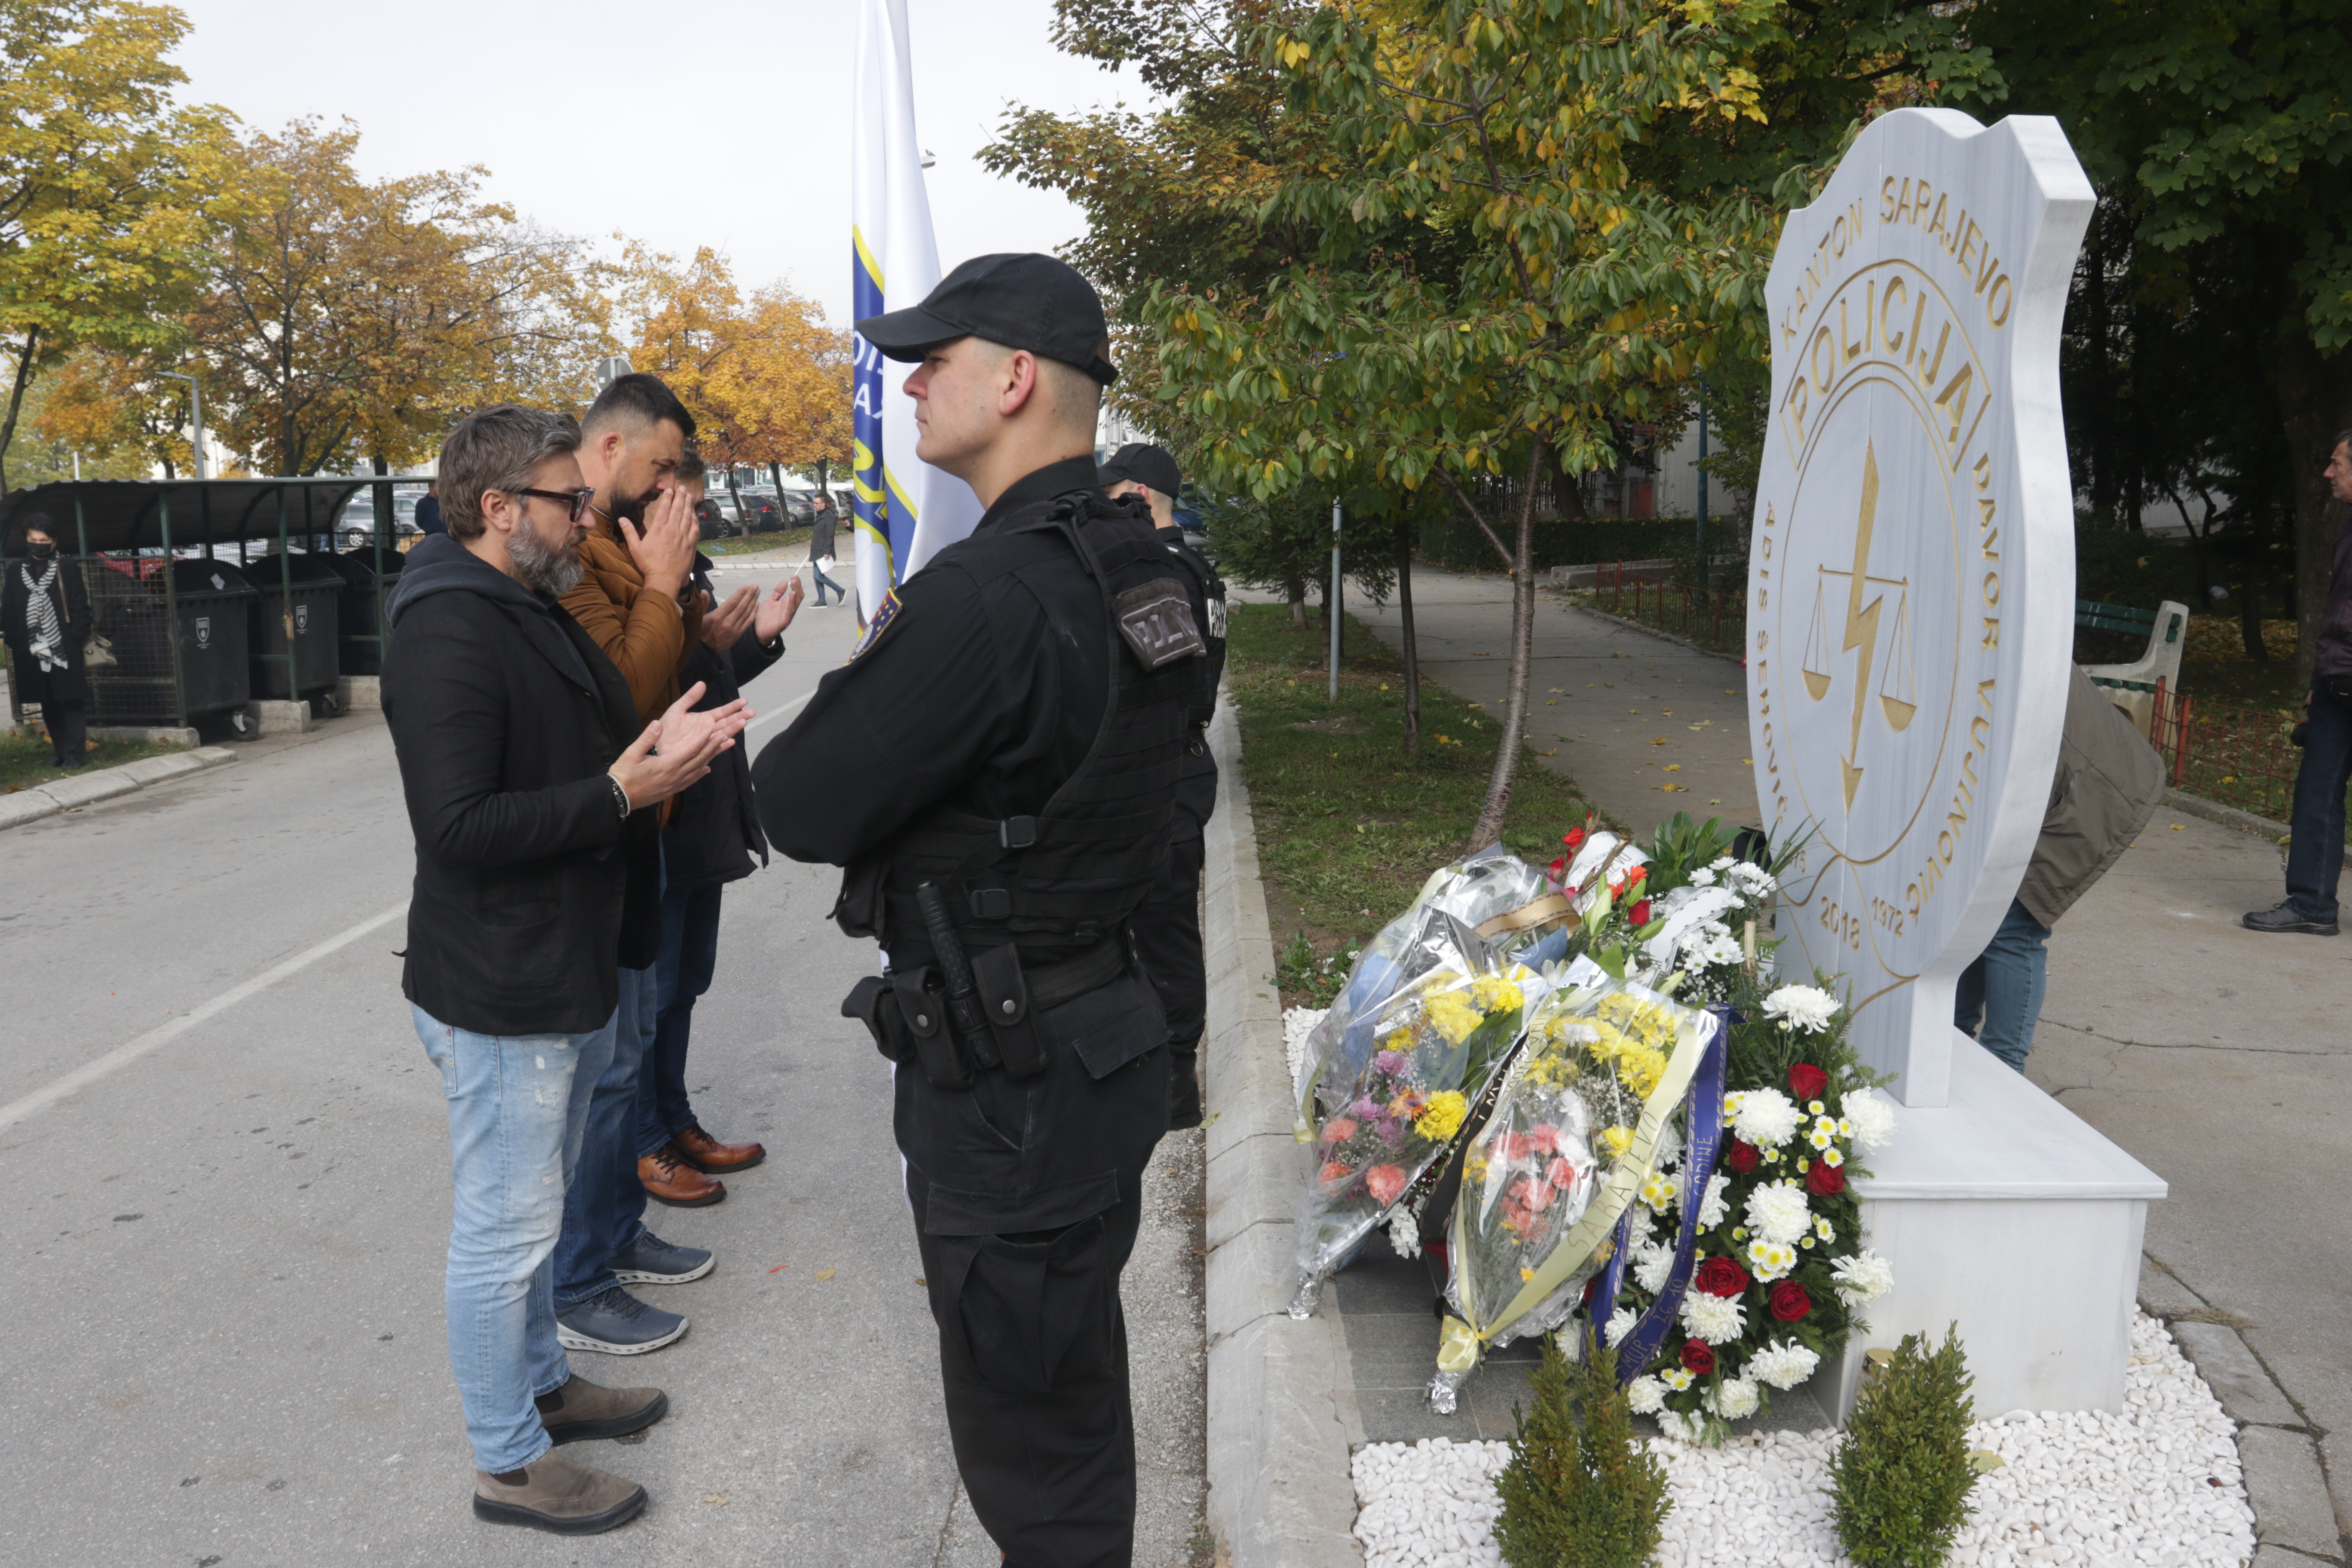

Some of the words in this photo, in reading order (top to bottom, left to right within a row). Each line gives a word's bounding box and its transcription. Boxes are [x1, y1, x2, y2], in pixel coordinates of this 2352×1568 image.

[1780, 197, 1863, 352] KANTON
[1880, 175, 2012, 332] SARAJEVO
[1788, 275, 1974, 452] POLICIJA
[1758, 499, 1776, 611] ADIS
[1972, 451, 2000, 652] DAVOR
[1906, 678, 1996, 927] VUJINOVIĆ
[1820, 896, 1861, 951] 2018
[1872, 895, 1904, 938] 1972
[1567, 1111, 1660, 1255] SARAJEVO
[1694, 1135, 1713, 1197] GODINE
